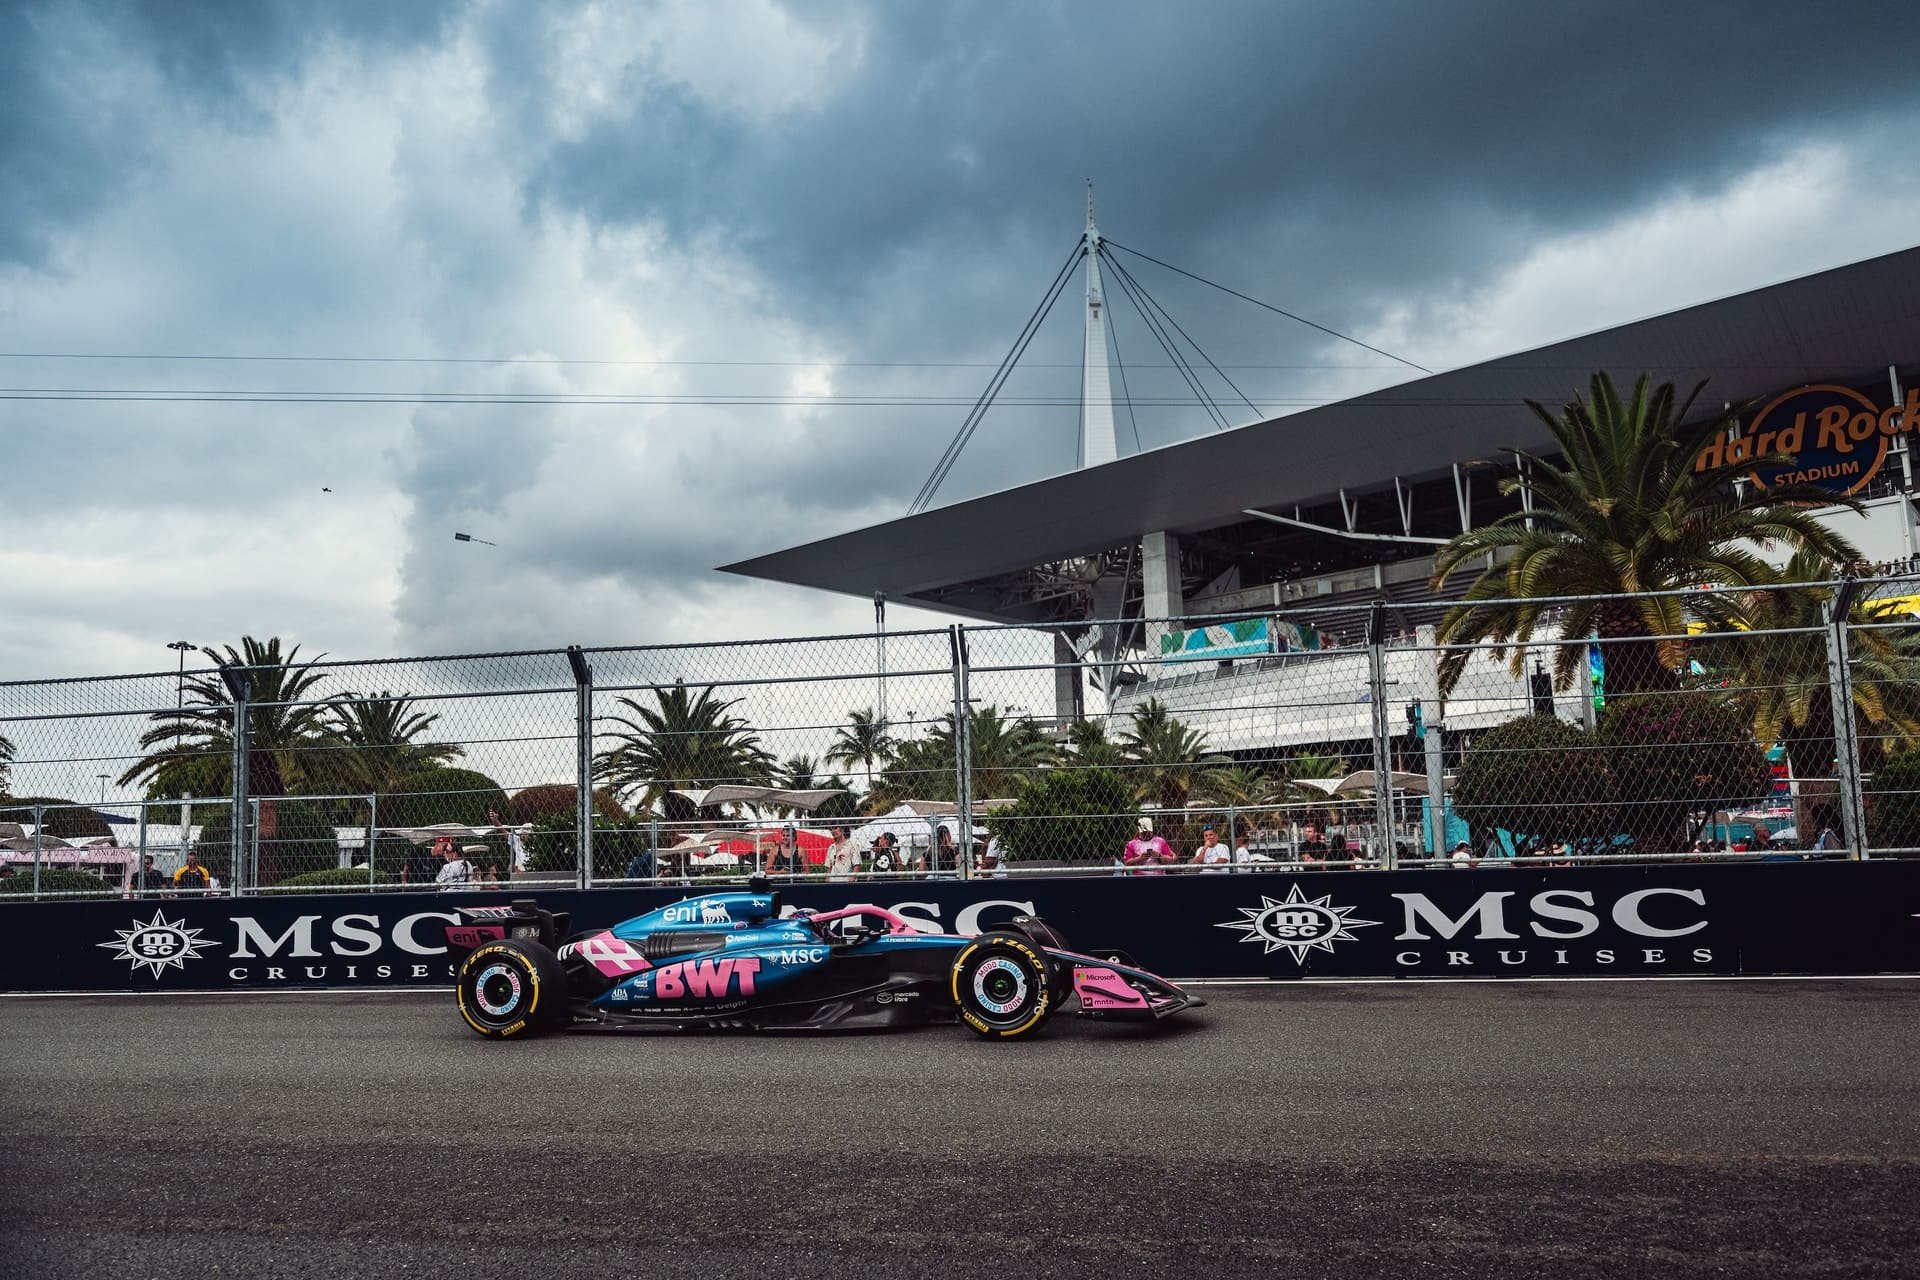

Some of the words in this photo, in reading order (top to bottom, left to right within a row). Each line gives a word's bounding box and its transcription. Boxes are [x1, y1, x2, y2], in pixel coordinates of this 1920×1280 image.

[1695, 411, 1807, 473] Hard
[1774, 460, 1860, 487] STADIUM
[663, 902, 698, 922] eni
[1391, 887, 1709, 940] MSC
[229, 911, 463, 958] MSC
[453, 930, 477, 943] eni
[781, 948, 823, 965] MSC
[1005, 939, 1044, 969] ZERO
[1395, 947, 1714, 966] CRUISES
[478, 968, 496, 988] CASINO
[656, 958, 761, 999] BWT
[978, 961, 997, 978] MODO
[998, 960, 1023, 979] CASINO
[509, 971, 520, 993] MODO
[477, 989, 489, 1009] MODO
[978, 993, 1002, 1013] CASINO
[1003, 995, 1023, 1012] MODO
